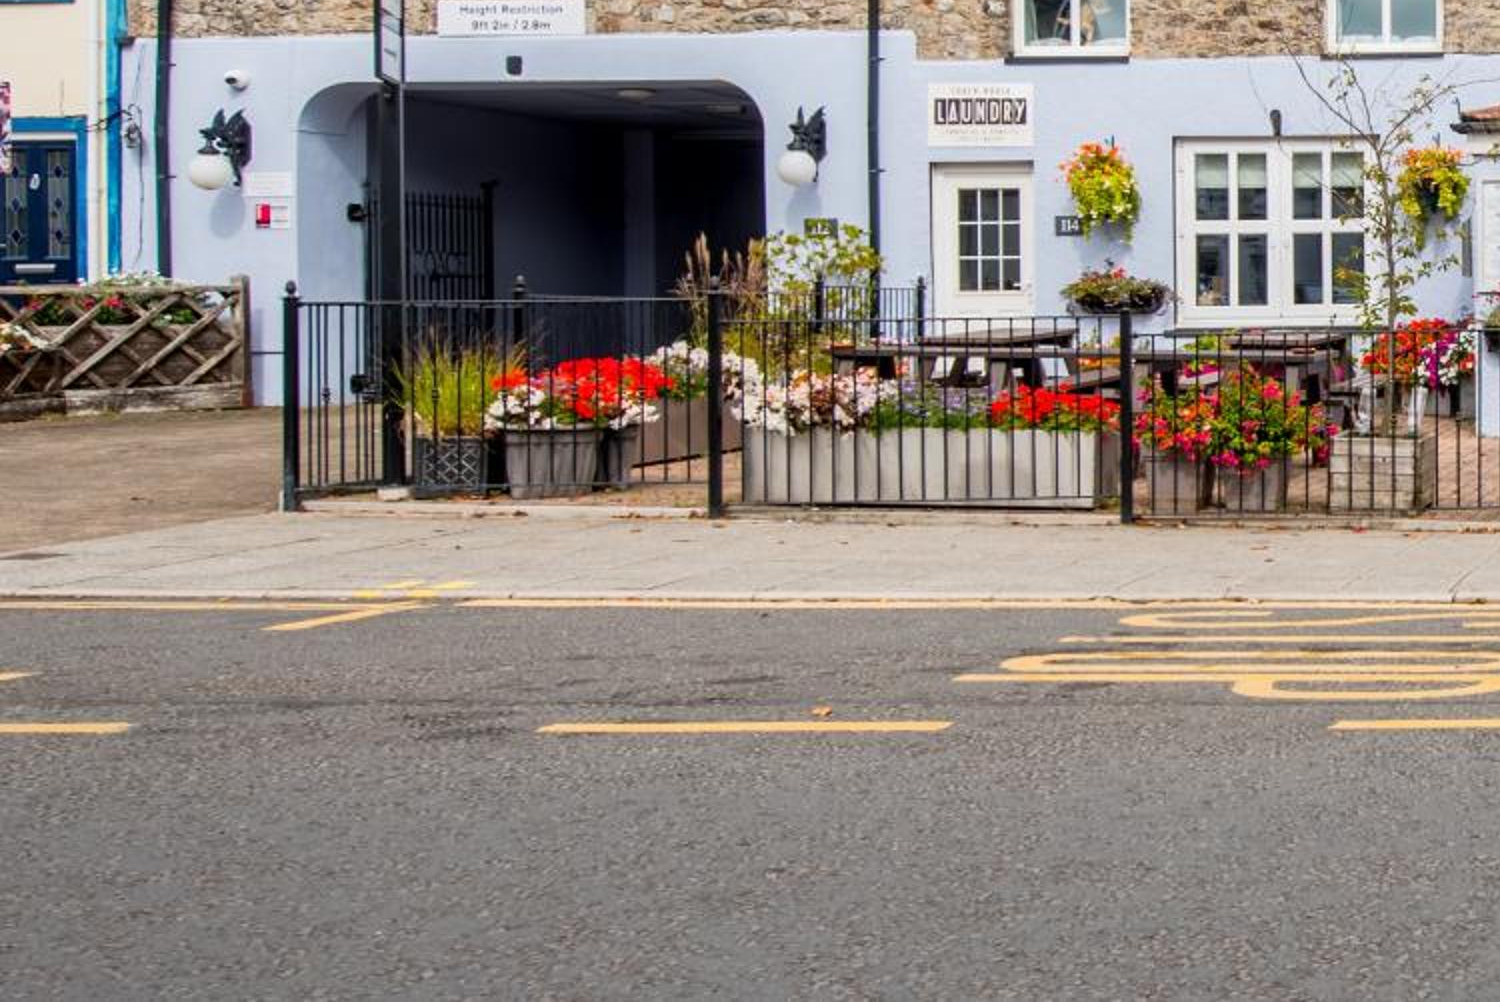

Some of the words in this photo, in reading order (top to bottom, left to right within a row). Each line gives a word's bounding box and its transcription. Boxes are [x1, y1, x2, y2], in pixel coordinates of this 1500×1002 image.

[459, 5, 497, 16] Height
[501, 5, 563, 15] Restriction
[471, 20, 488, 30] 9ft
[935, 99, 1026, 123] LAUNDRY
[1060, 219, 1079, 231] 114
